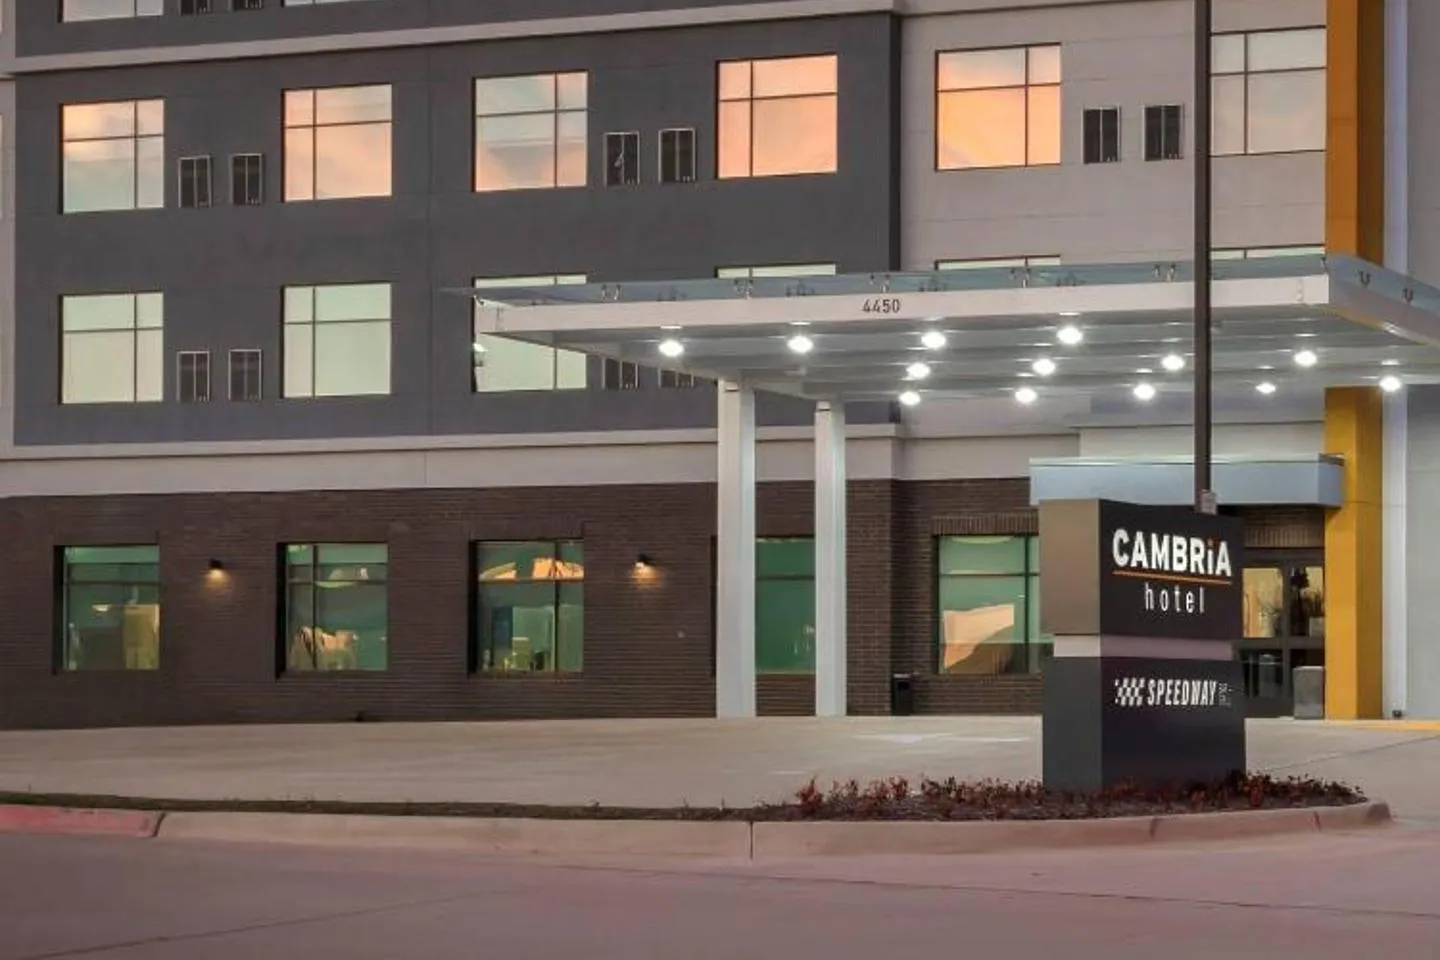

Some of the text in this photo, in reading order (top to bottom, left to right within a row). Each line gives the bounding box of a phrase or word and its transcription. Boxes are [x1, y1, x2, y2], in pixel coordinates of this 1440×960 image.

[862, 299, 900, 313] 4450
[1144, 582, 1205, 613] hotel
[1147, 679, 1217, 706] SPEEDWAY
